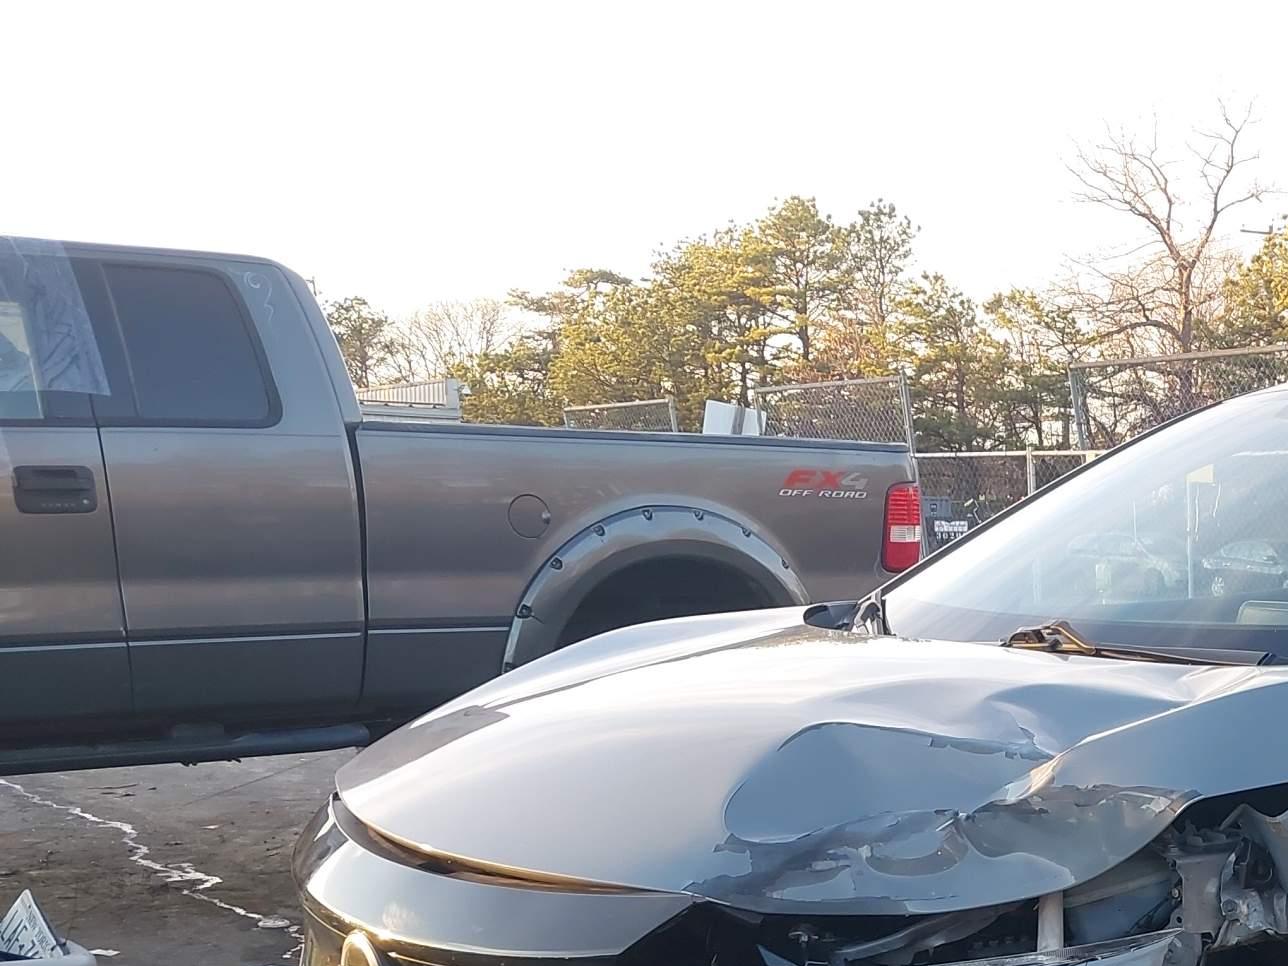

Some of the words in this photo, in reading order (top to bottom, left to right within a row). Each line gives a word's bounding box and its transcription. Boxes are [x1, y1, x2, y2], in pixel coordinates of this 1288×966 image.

[783, 469, 868, 489] FX4
[779, 489, 813, 497] OFF
[818, 490, 867, 499] ROAD
